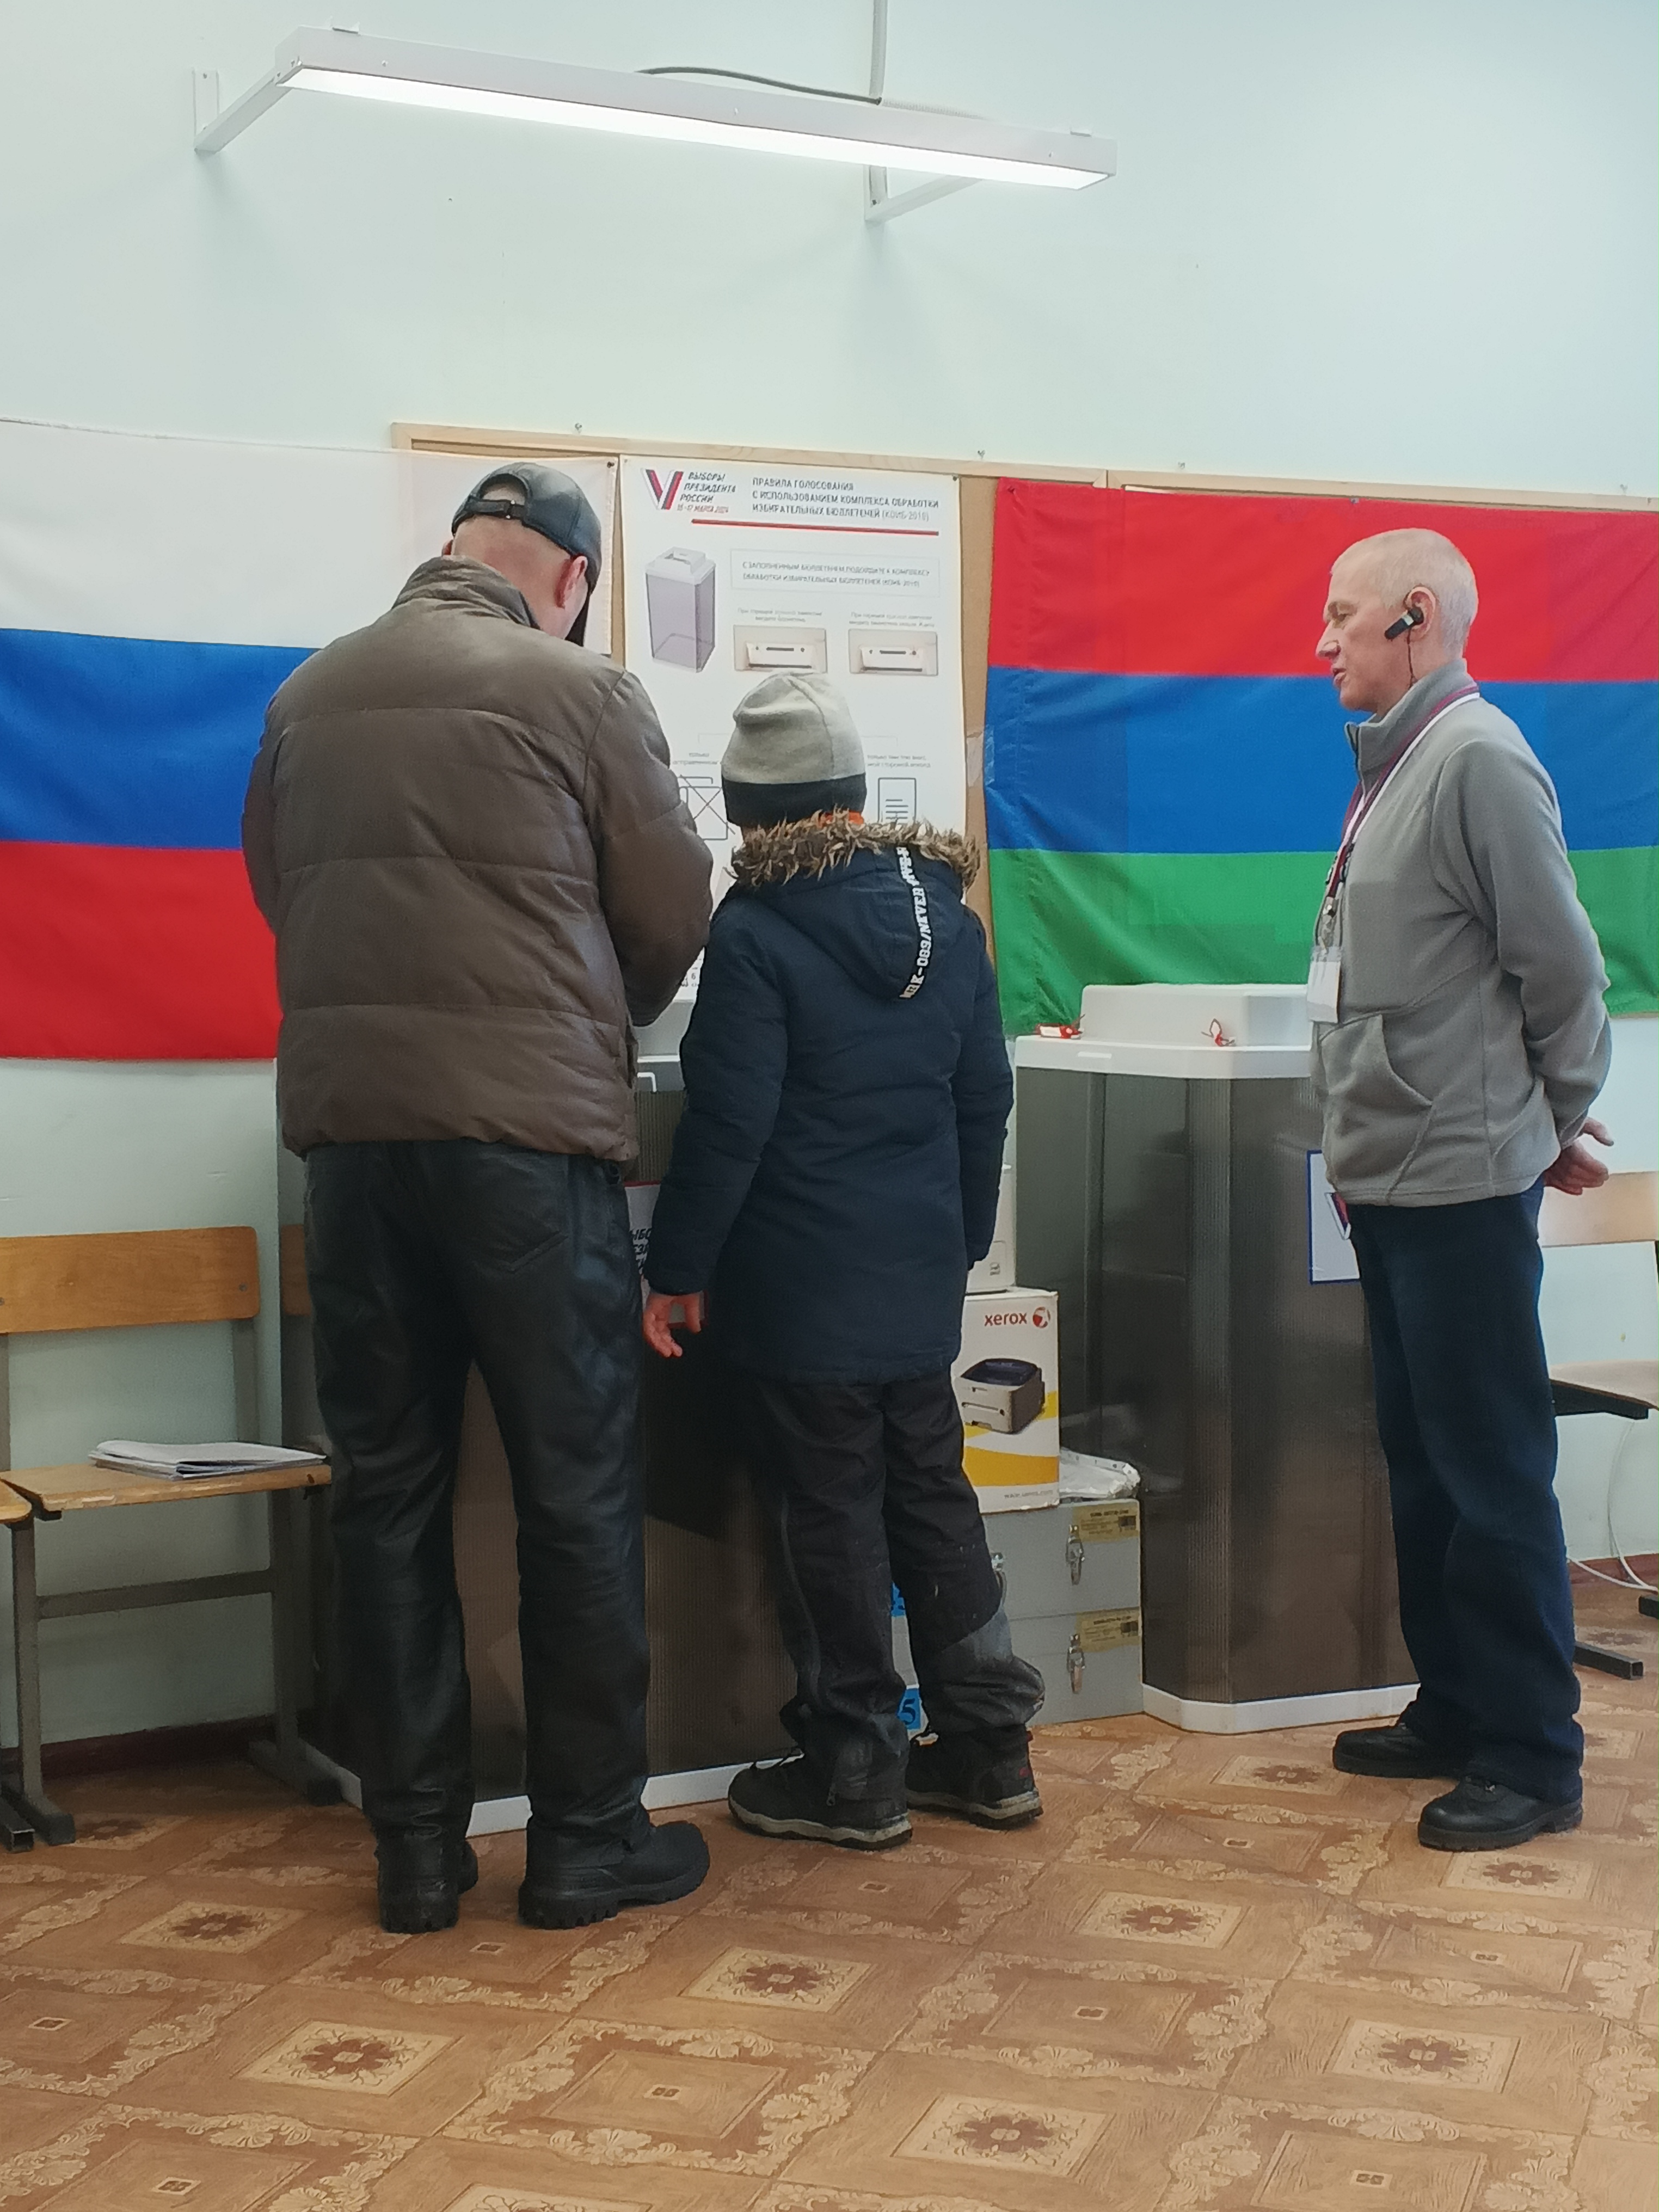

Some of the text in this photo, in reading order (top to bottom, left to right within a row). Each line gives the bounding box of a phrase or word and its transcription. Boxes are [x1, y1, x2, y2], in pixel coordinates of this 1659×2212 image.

[688, 471, 726, 482] ВЫБОРЫ
[684, 483, 736, 493] ПРЕЗИДЕНТА
[752, 477, 853, 490] ПРАВИЛА ГОЛОСОВАНИЯ
[680, 494, 714, 503] РОССИИ
[752, 490, 939, 508] С ИСПОЛЬЗОВАНИЕМ КОМПЛЕКСА ОБРАБОТКИ
[752, 503, 824, 515] ИЗБИРАТЕЛЬНЫХ
[826, 508, 880, 518] БЮЛЛЕТЕНЕЙ
[984, 1312, 1028, 1326] xerox
[902, 1698, 916, 1725] 5
